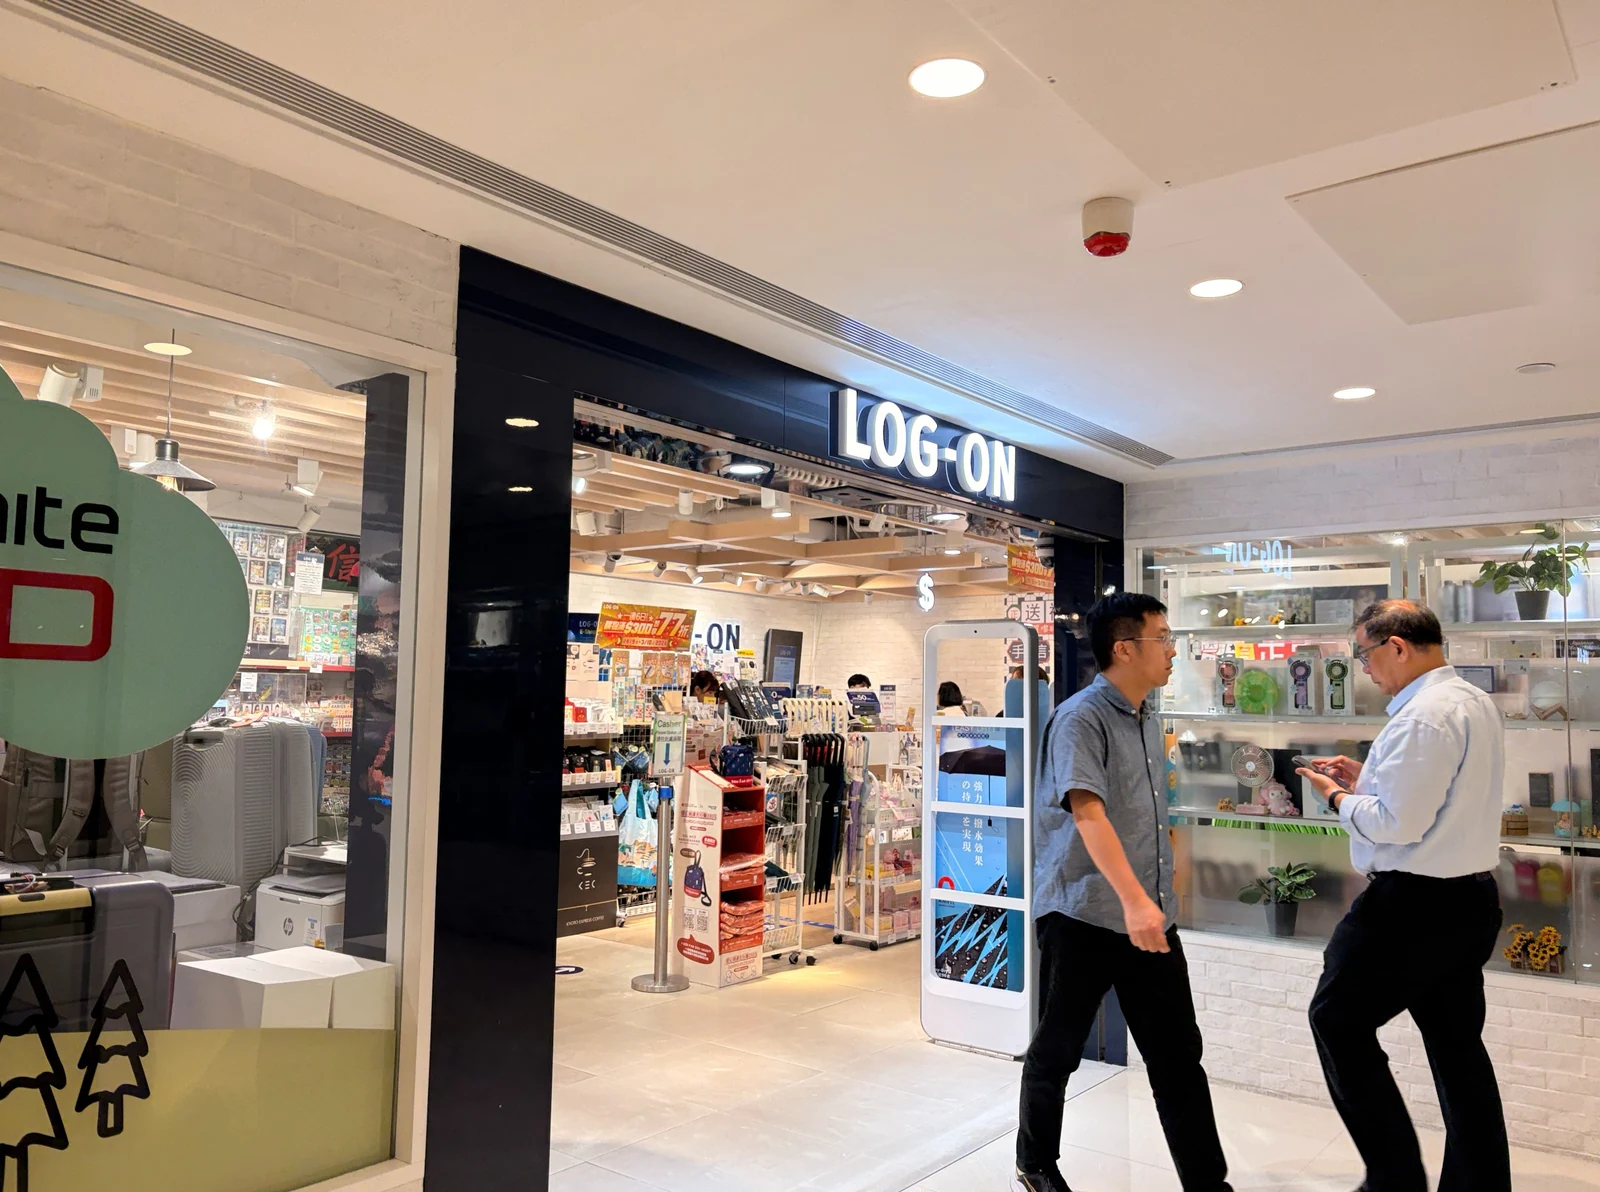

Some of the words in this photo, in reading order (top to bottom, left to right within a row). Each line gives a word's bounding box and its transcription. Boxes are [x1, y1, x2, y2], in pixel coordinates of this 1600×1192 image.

[837, 388, 1016, 502] LOG-ON
[327, 543, 360, 584] 信
[694, 623, 740, 651] -ON
[657, 719, 682, 728] Cashier
